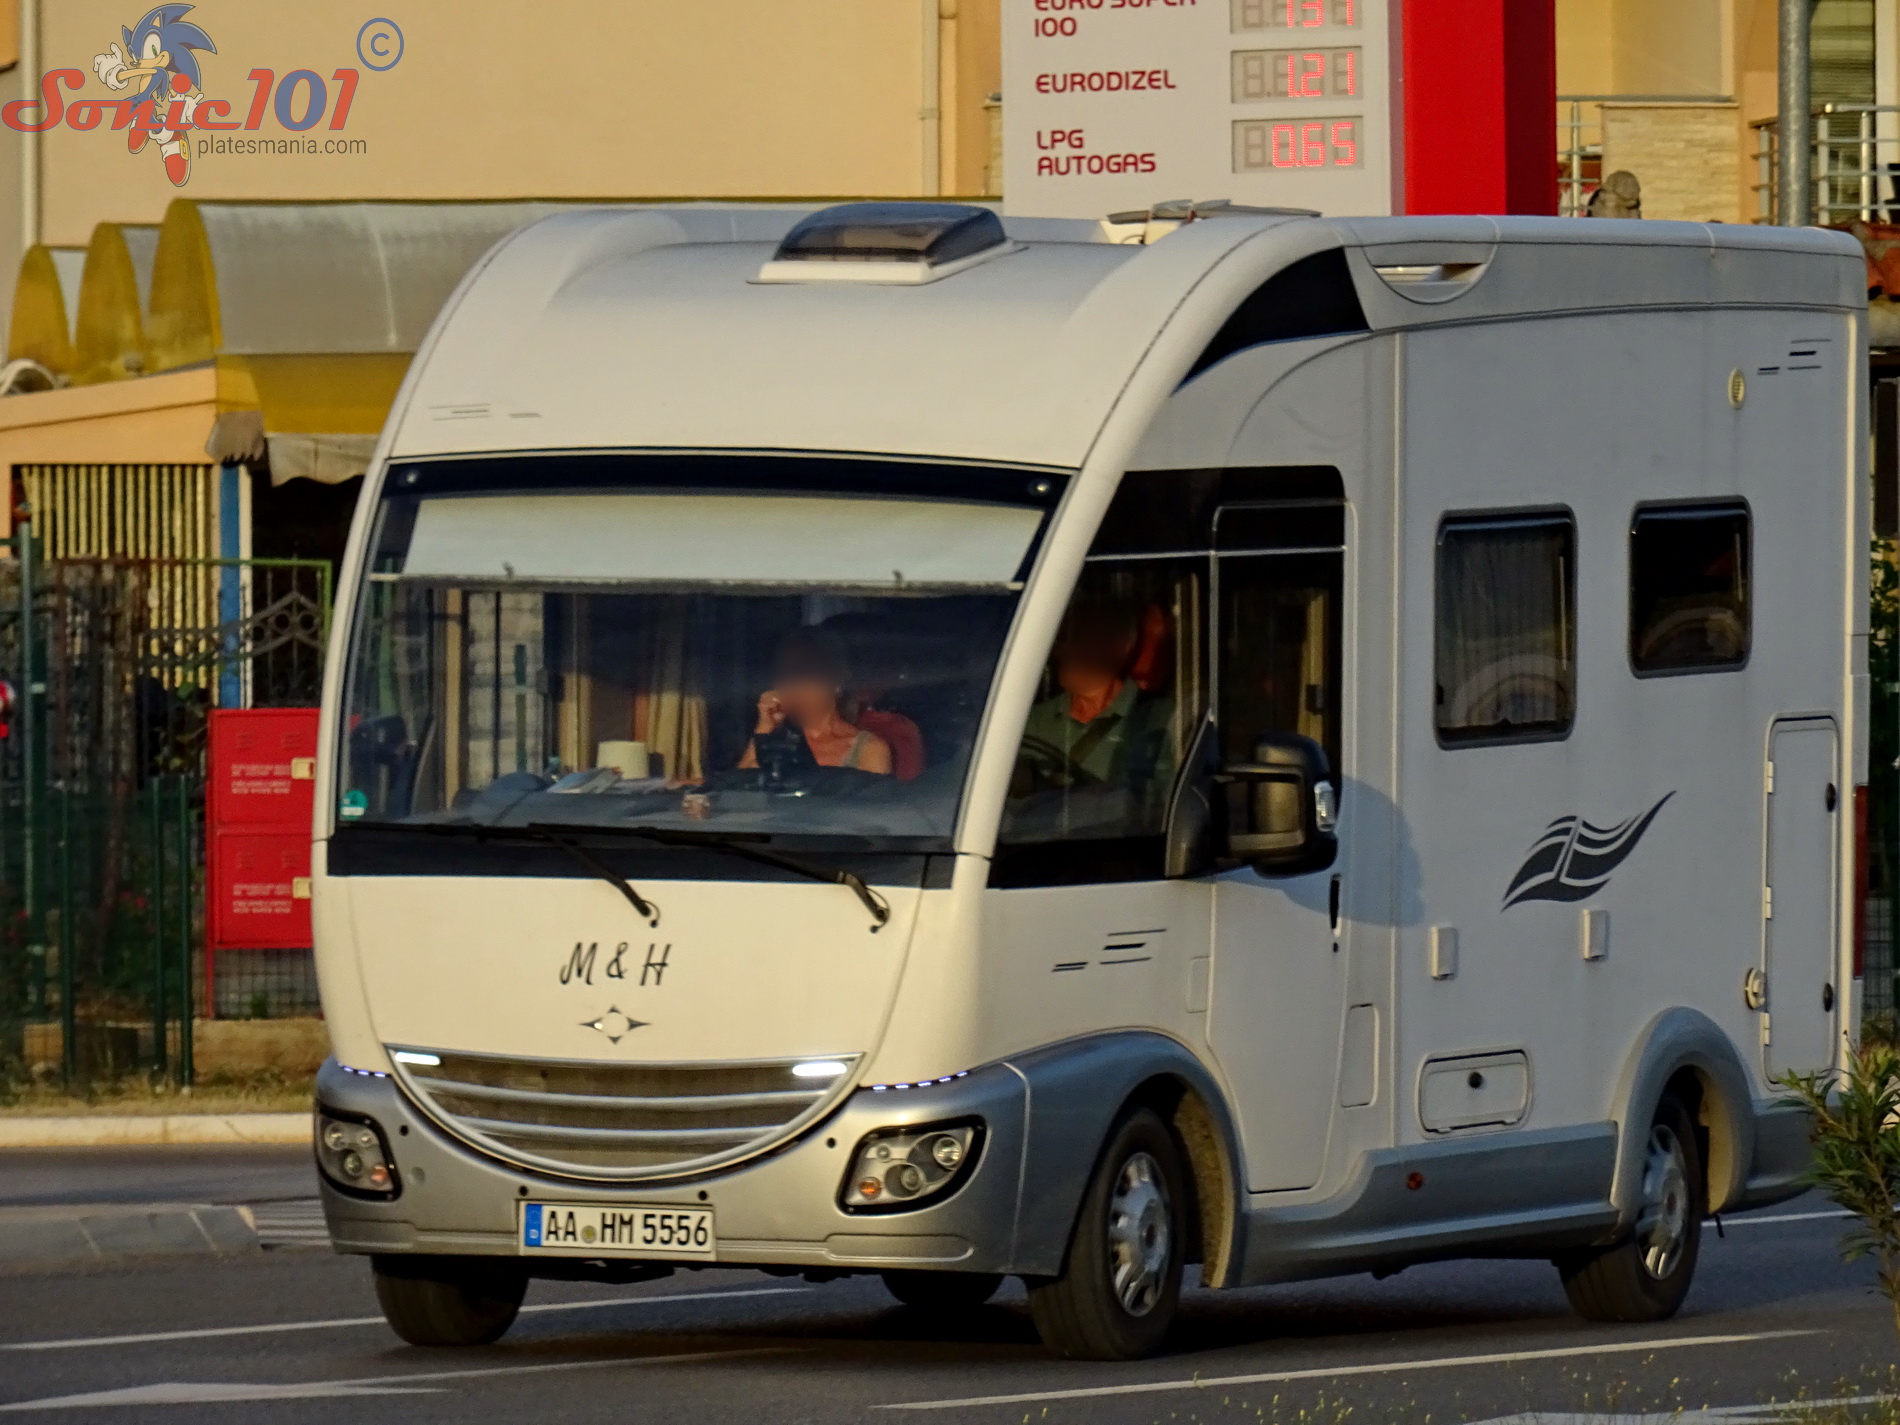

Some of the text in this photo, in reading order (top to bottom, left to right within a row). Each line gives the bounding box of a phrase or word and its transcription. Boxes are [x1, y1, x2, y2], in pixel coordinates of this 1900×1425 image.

[1034, 17, 1077, 38] 100
[1035, 70, 1177, 94] EURODIZEL
[1287, 52, 1355, 98] 1.21
[1036, 129, 1084, 150] LPG
[1271, 122, 1356, 168] 0.65
[1037, 153, 1157, 176] AUTOGAS
[559, 941, 672, 986] M & H
[545, 1210, 708, 1247] AA HM 5556
